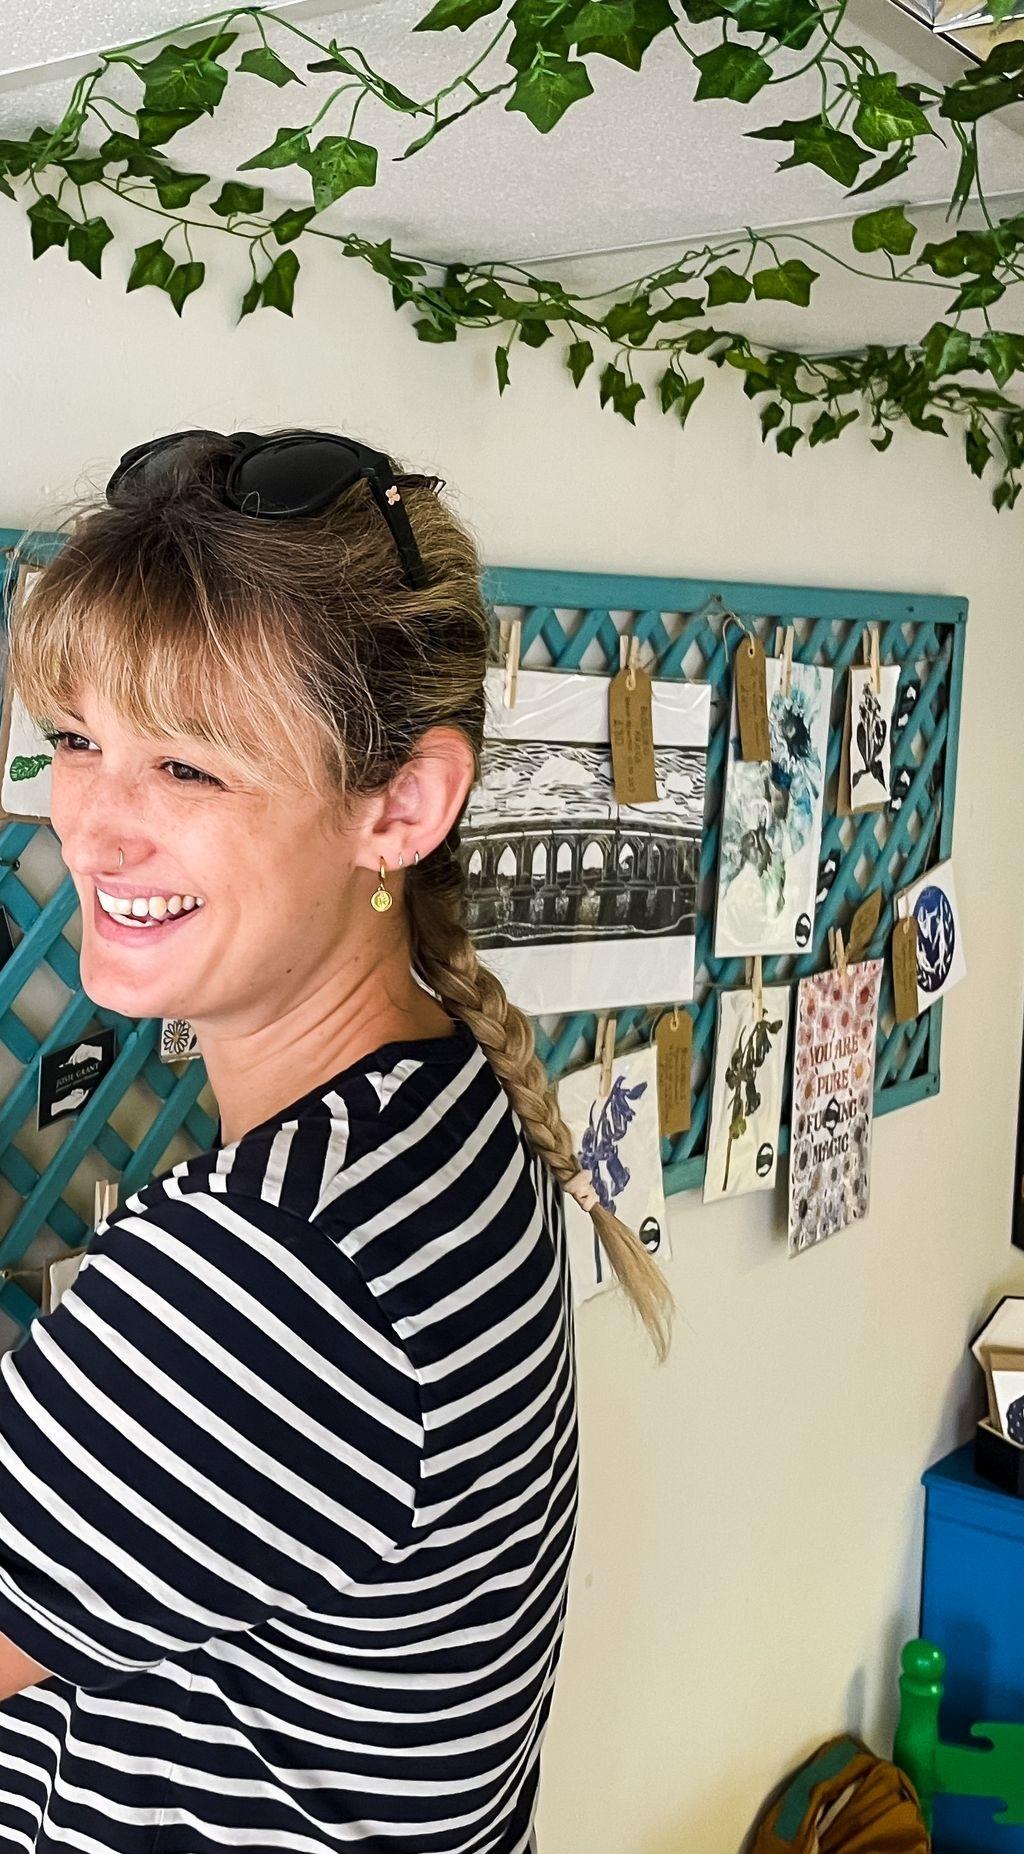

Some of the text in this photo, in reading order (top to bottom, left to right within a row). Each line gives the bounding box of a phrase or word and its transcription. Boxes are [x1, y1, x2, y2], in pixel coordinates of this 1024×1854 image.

[810, 1036, 858, 1067] YOU ARE
[76, 1062, 100, 1079] GRANT
[816, 1070, 849, 1097] PURE
[812, 1133, 849, 1166] MAGIC
